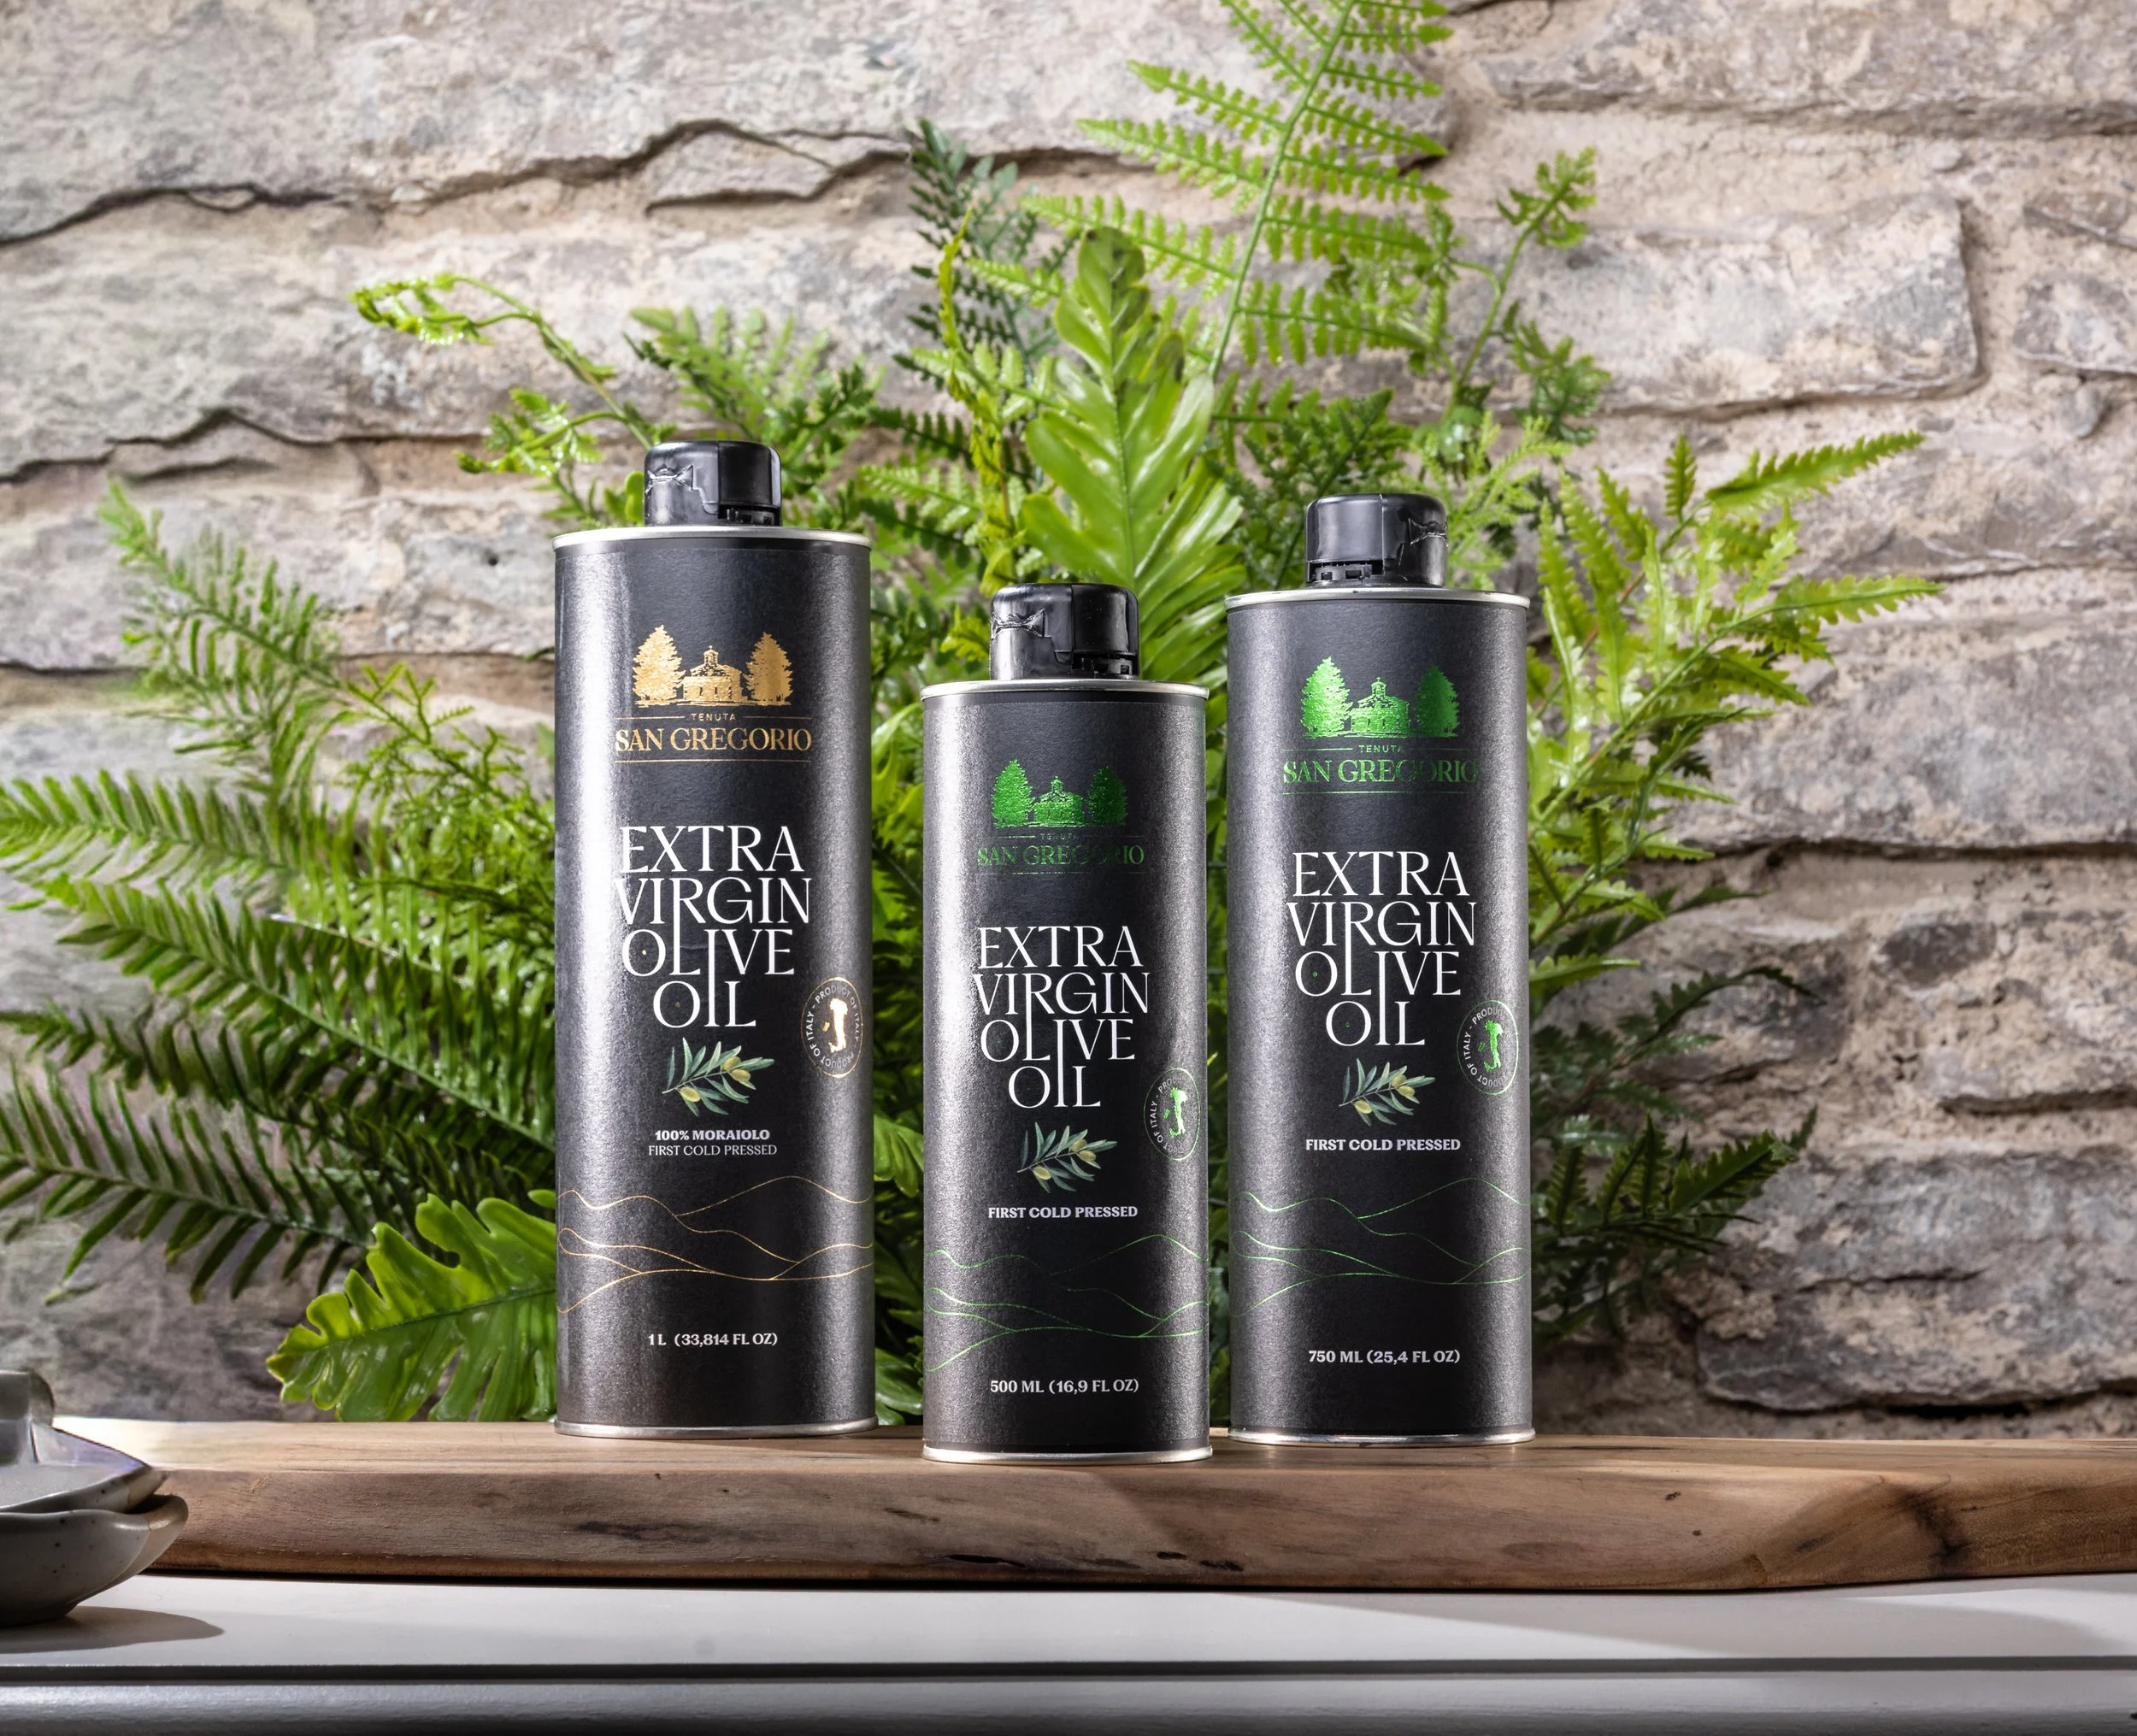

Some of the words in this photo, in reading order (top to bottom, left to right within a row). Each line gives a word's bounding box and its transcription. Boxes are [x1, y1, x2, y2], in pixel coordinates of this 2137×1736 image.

[691, 713, 736, 721] TENUTA
[615, 727, 662, 752] SAN
[670, 727, 812, 752] GREGORIO
[1283, 759, 1333, 784] SAN
[619, 825, 804, 874] EXTRA
[976, 844, 1020, 867] SAN
[1292, 850, 1470, 897] EXTRA
[613, 877, 812, 925] VIRGIN
[1286, 900, 1477, 947] VIRGIN
[622, 928, 795, 977] OLIVE
[978, 925, 1144, 969] EXTRA
[1295, 950, 1461, 997] OLIVE
[652, 980, 756, 1028] OIL
[815, 985, 851, 1003] PRODUCT
[972, 971, 1151, 1015] VIRGIN
[805, 1010, 815, 1041] ITALY
[1325, 1000, 1426, 1047] OIL
[809, 1043, 821, 1057] OF
[980, 1018, 1135, 1062] OLIVE
[1463, 1031, 1471, 1061] ITALY
[1008, 1065, 1101, 1109] OIL
[1149, 1100, 1158, 1128] ITALY
[655, 1129, 690, 1141] 100%
[692, 1129, 770, 1141] MORAIOLO
[1305, 1139, 1346, 1150] FIRST
[1348, 1139, 1393, 1150] COLD
[1396, 1139, 1461, 1150] PRESSED
[648, 1145, 680, 1156] FIRST
[683, 1145, 721, 1156] COLD
[723, 1145, 777, 1156] PRESSED
[987, 1207, 1026, 1219] FIRST
[1028, 1206, 1072, 1219] COLD
[1074, 1206, 1139, 1219] PRESSED
[674, 1333, 729, 1347] (33,814
[733, 1333, 750, 1345] FL
[752, 1333, 778, 1346] OZ)
[1308, 1350, 1336, 1363] 750
[1339, 1350, 1363, 1363] ML
[1366, 1350, 1409, 1365] (25,4
[1411, 1350, 1431, 1363] FL
[1433, 1349, 1461, 1364] OZ)
[990, 1380, 1018, 1393] 500
[1021, 1380, 1045, 1393] ML
[1048, 1380, 1088, 1395] (16,9
[1092, 1380, 1110, 1392] FL
[1112, 1378, 1139, 1393] OZ)
